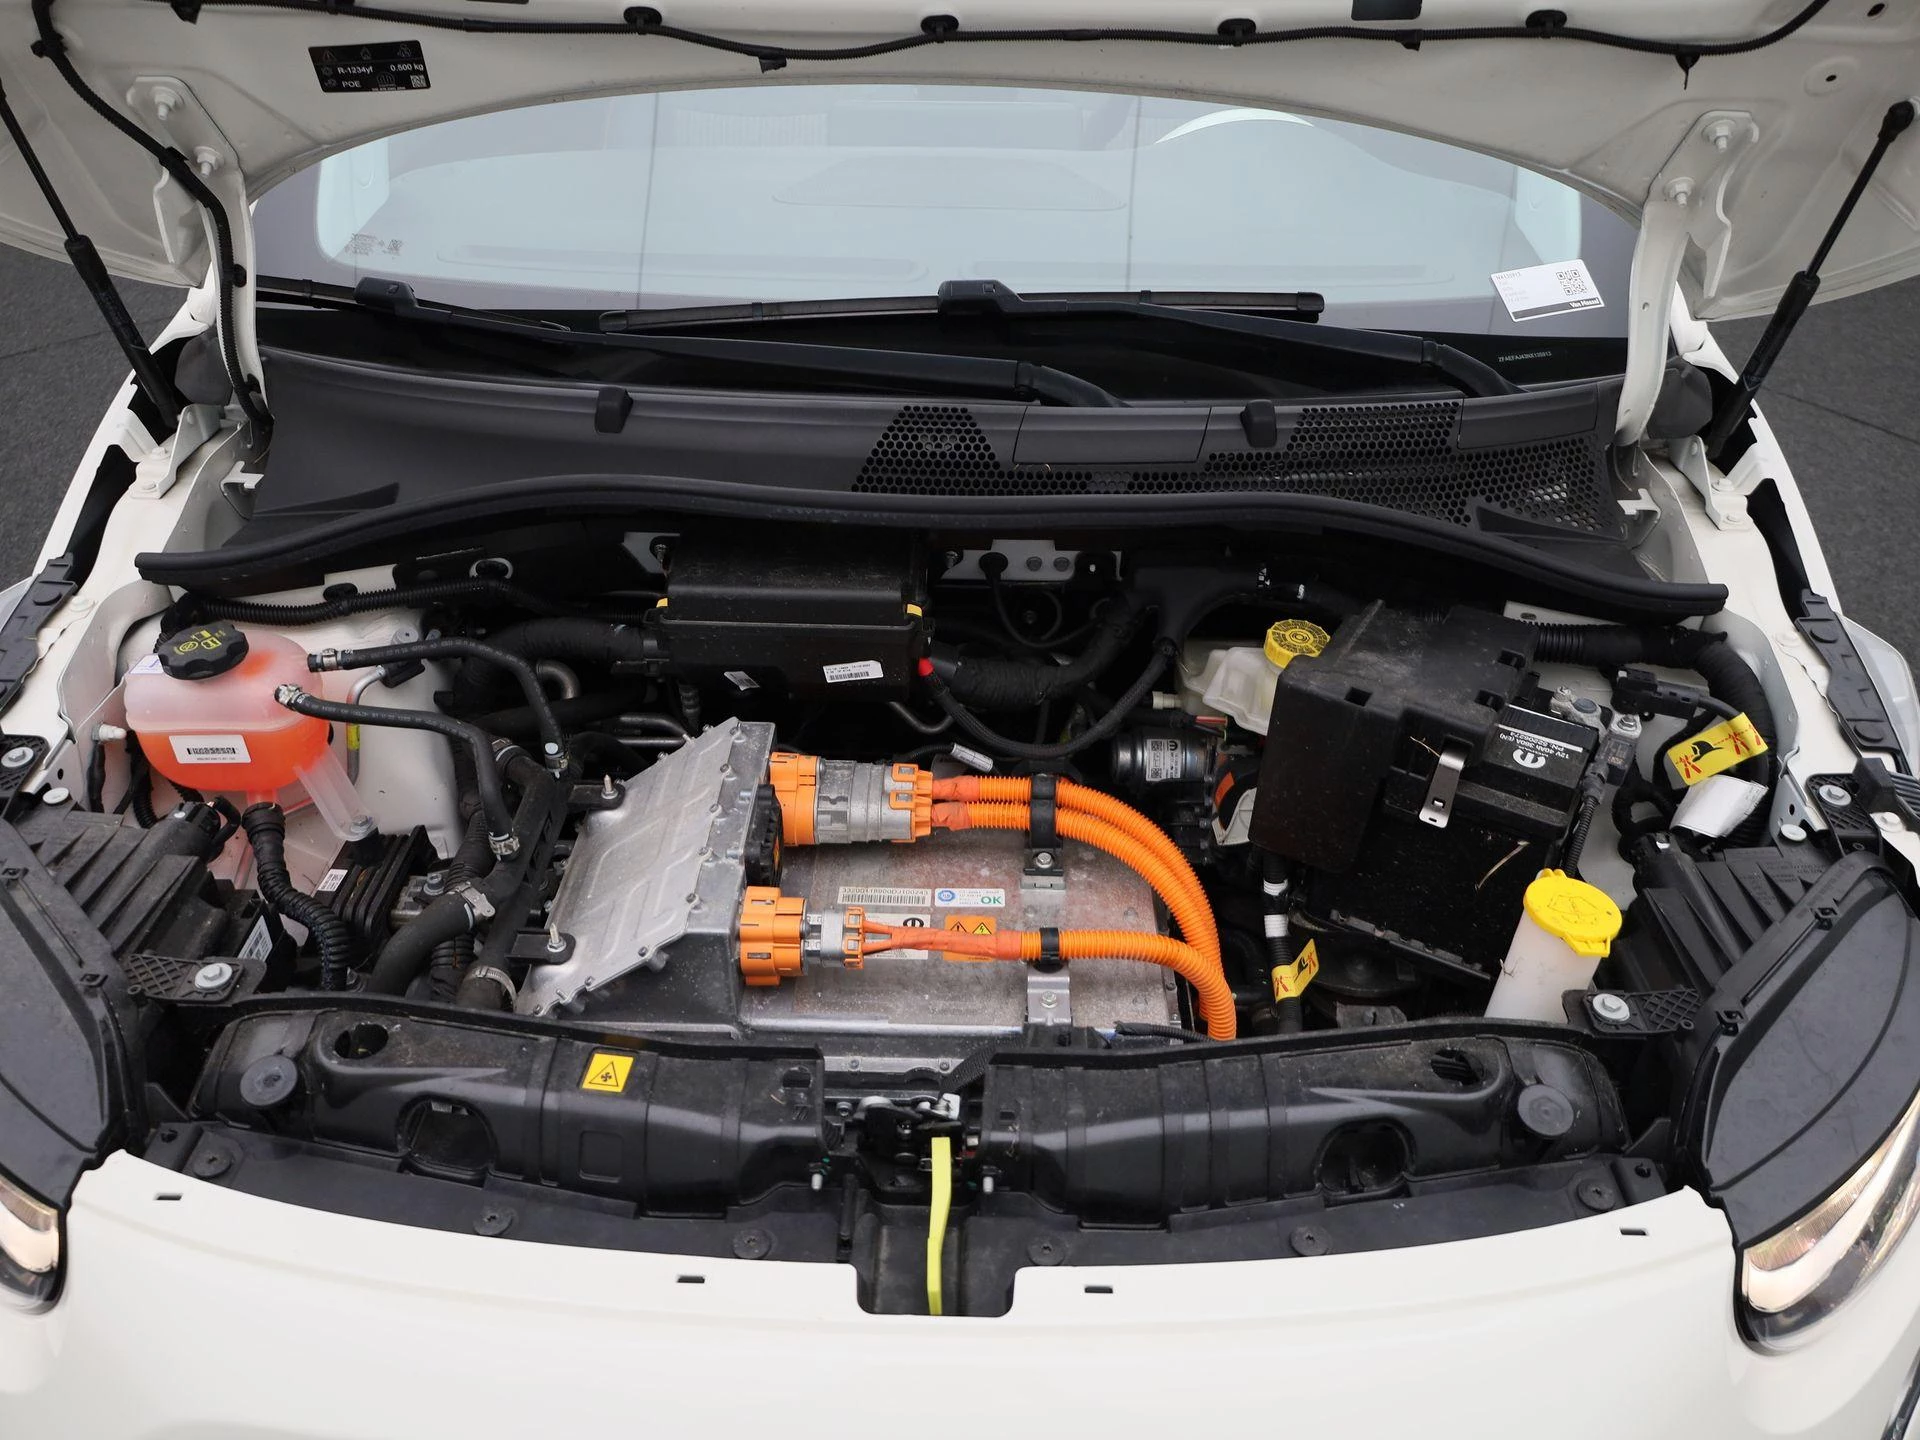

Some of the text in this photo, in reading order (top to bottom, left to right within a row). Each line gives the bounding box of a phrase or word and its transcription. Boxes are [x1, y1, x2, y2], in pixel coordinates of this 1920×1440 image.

[413, 63, 424, 72] kg
[342, 80, 361, 88] POE
[1555, 751, 1570, 759] 12V
[980, 895, 1001, 905] OK
